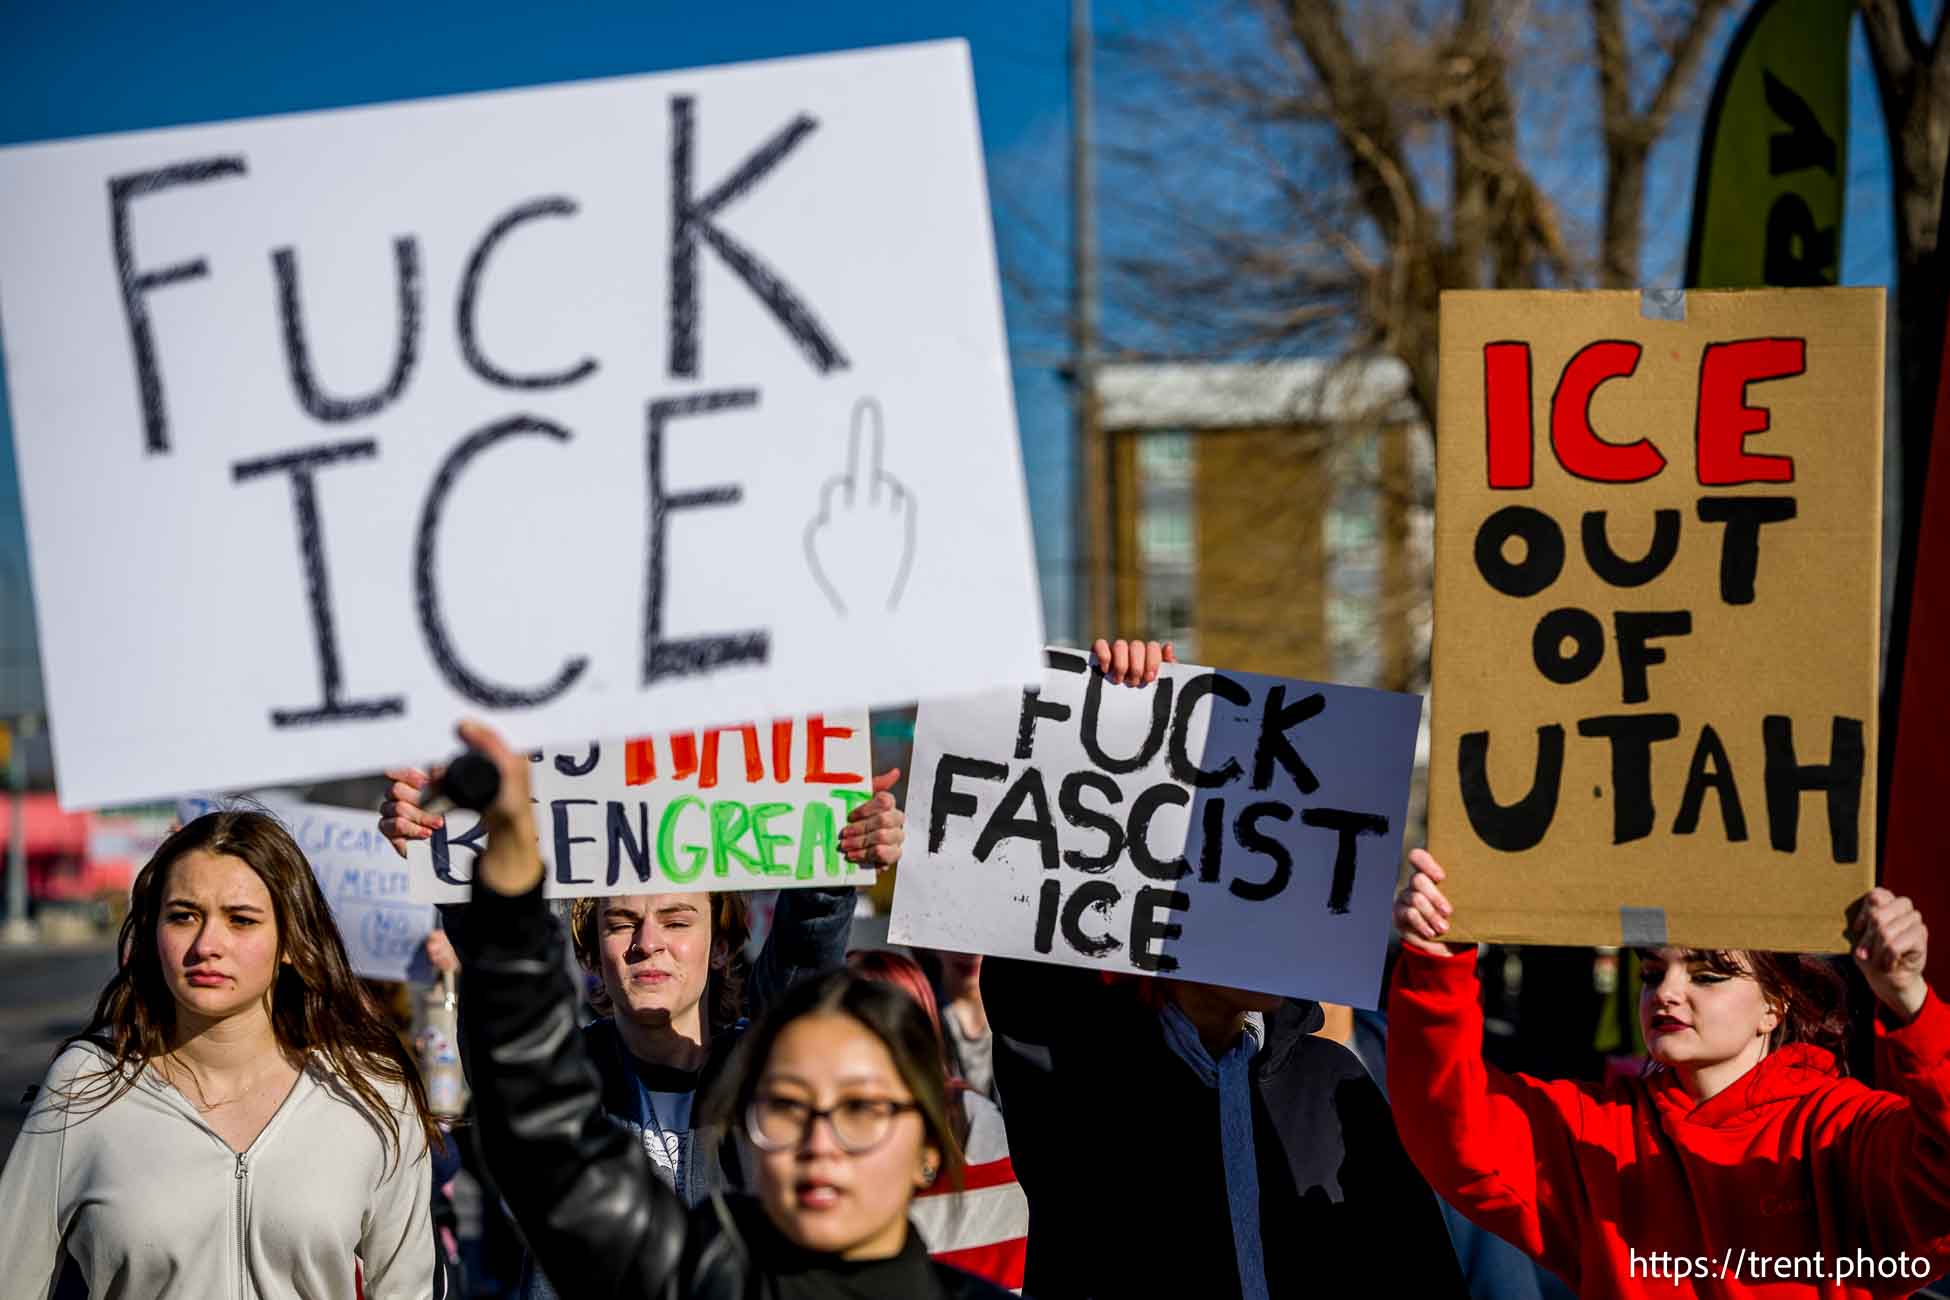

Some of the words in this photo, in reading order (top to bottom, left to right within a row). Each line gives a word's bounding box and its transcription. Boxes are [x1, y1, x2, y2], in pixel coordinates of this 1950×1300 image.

[108, 95, 850, 456] FUCK
[1483, 337, 1806, 490] ICE
[232, 389, 770, 729] ICE
[1474, 497, 1797, 605] OUT
[1014, 649, 1326, 795] FUCK
[1532, 608, 1692, 704] OF
[431, 798, 651, 887] BEN
[656, 788, 874, 885] GREAT
[928, 753, 1390, 914] FASCIST
[1458, 713, 1865, 864] UTAH
[1034, 878, 1191, 972] ICE
